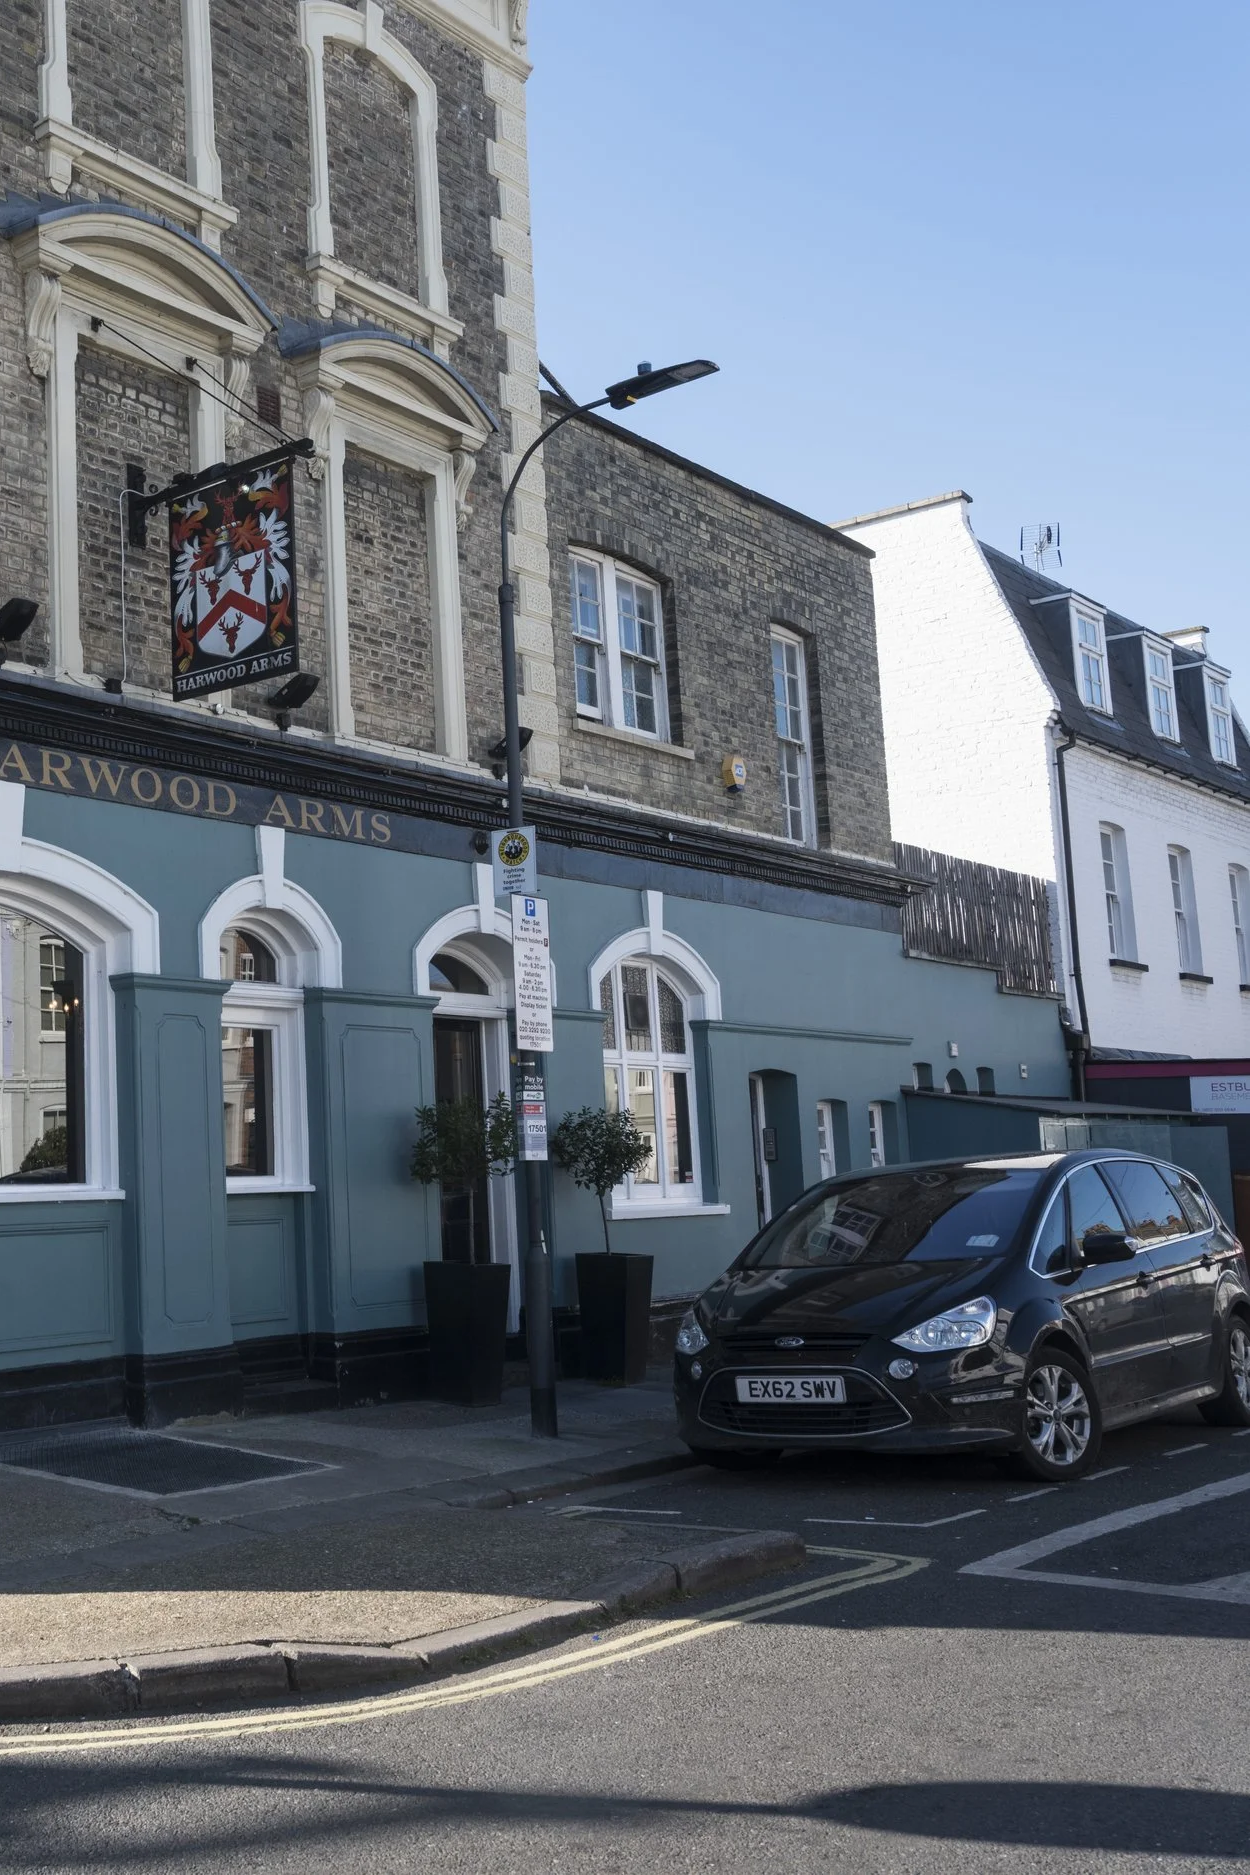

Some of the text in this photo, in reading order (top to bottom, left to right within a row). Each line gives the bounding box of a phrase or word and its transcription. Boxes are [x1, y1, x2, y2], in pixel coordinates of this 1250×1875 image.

[177, 652, 292, 693] HARWOOD ARMS
[262, 792, 392, 844] ARMS
[521, 1001, 535, 1009] Display
[528, 1125, 546, 1133] 17501
[748, 1381, 836, 1398] EX62 SWV
